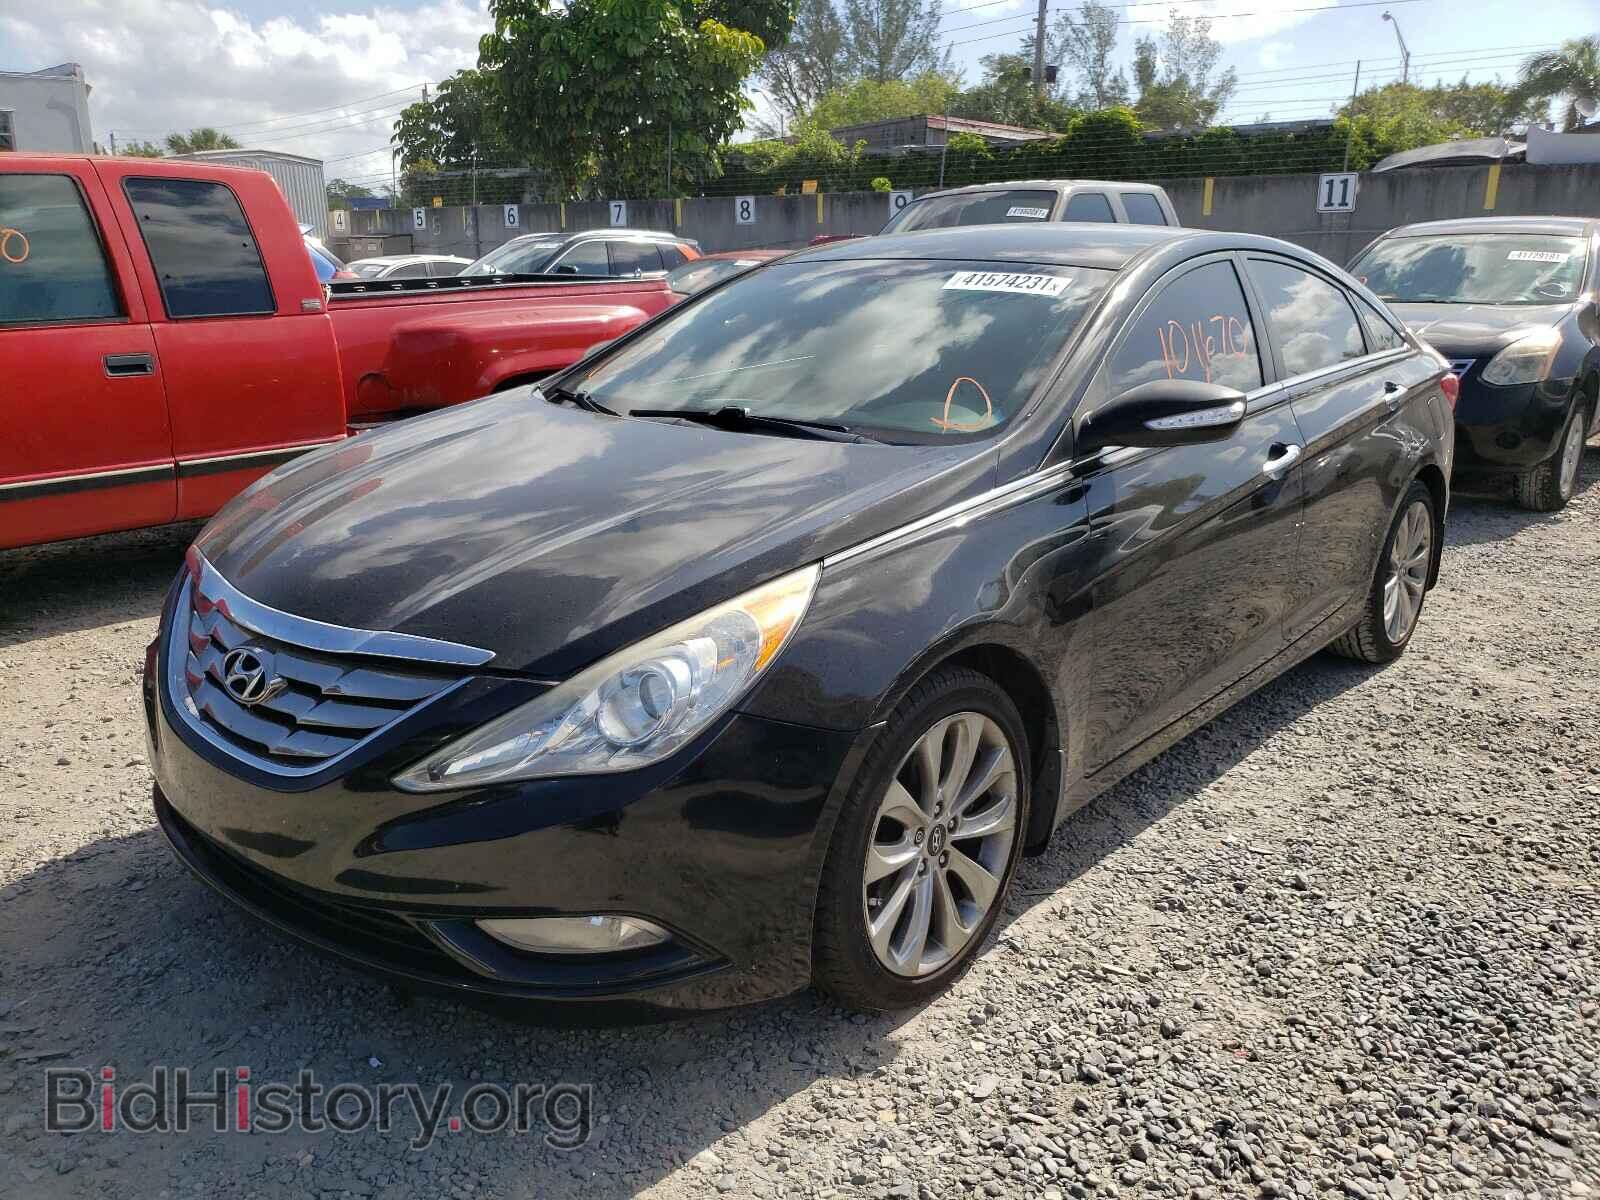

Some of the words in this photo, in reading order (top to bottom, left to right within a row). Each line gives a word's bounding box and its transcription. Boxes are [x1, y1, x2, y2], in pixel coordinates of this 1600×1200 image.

[1323, 178, 1349, 208] 11
[336, 213, 343, 226] 4
[416, 210, 423, 226] 5
[507, 207, 516, 225] 6
[613, 204, 624, 223] 7
[740, 200, 751, 221] 8
